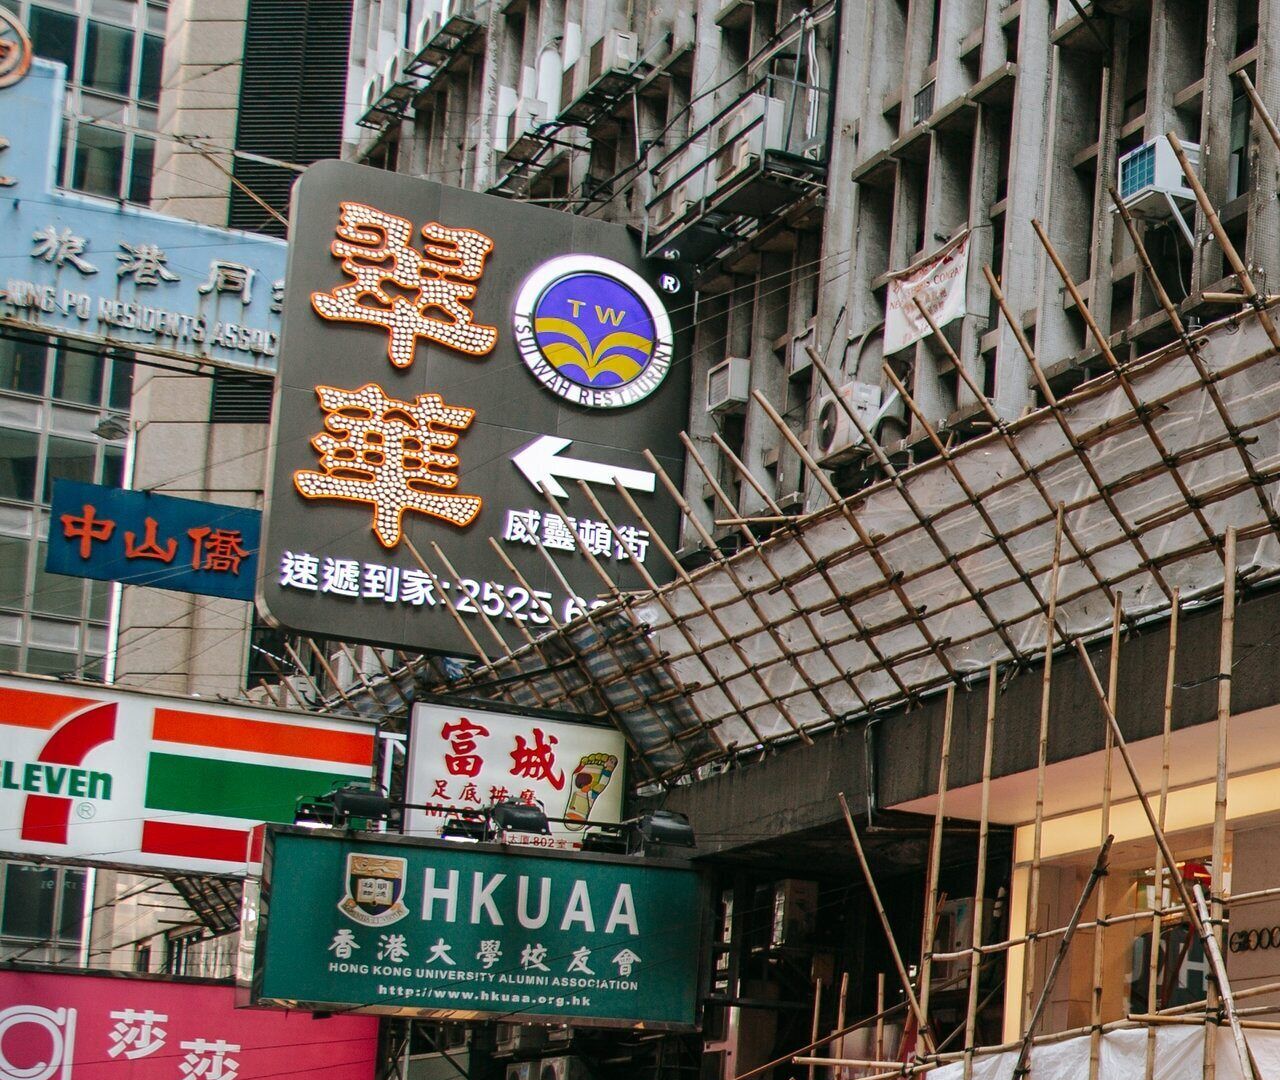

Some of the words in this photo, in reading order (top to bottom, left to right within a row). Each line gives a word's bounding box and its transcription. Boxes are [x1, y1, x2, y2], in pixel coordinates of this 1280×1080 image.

[29, 225, 286, 314] 旅港同
[98, 295, 207, 342] RESIDENTS
[211, 319, 278, 357] ASSOC
[294, 200, 498, 550] 翠華
[513, 312, 542, 356] TSUI
[532, 357, 571, 397] WAH
[579, 337, 674, 408] RESTAURANT
[60, 503, 250, 576] 中山僑
[503, 508, 651, 564] 威靈頓街
[0, 759, 113, 801] LEVEn
[441, 716, 565, 791] 富城
[421, 867, 640, 936] HKUAA
[328, 928, 642, 978] 香港大學校友會
[329, 962, 369, 975] HONG
[373, 964, 412, 978] KONG
[415, 967, 495, 983] UNIVERSITY
[499, 973, 549, 987] ALUMNI
[552, 975, 639, 991] ASSOCIATION
[378, 984, 591, 1007] http://www.hkuaa.org.hk
